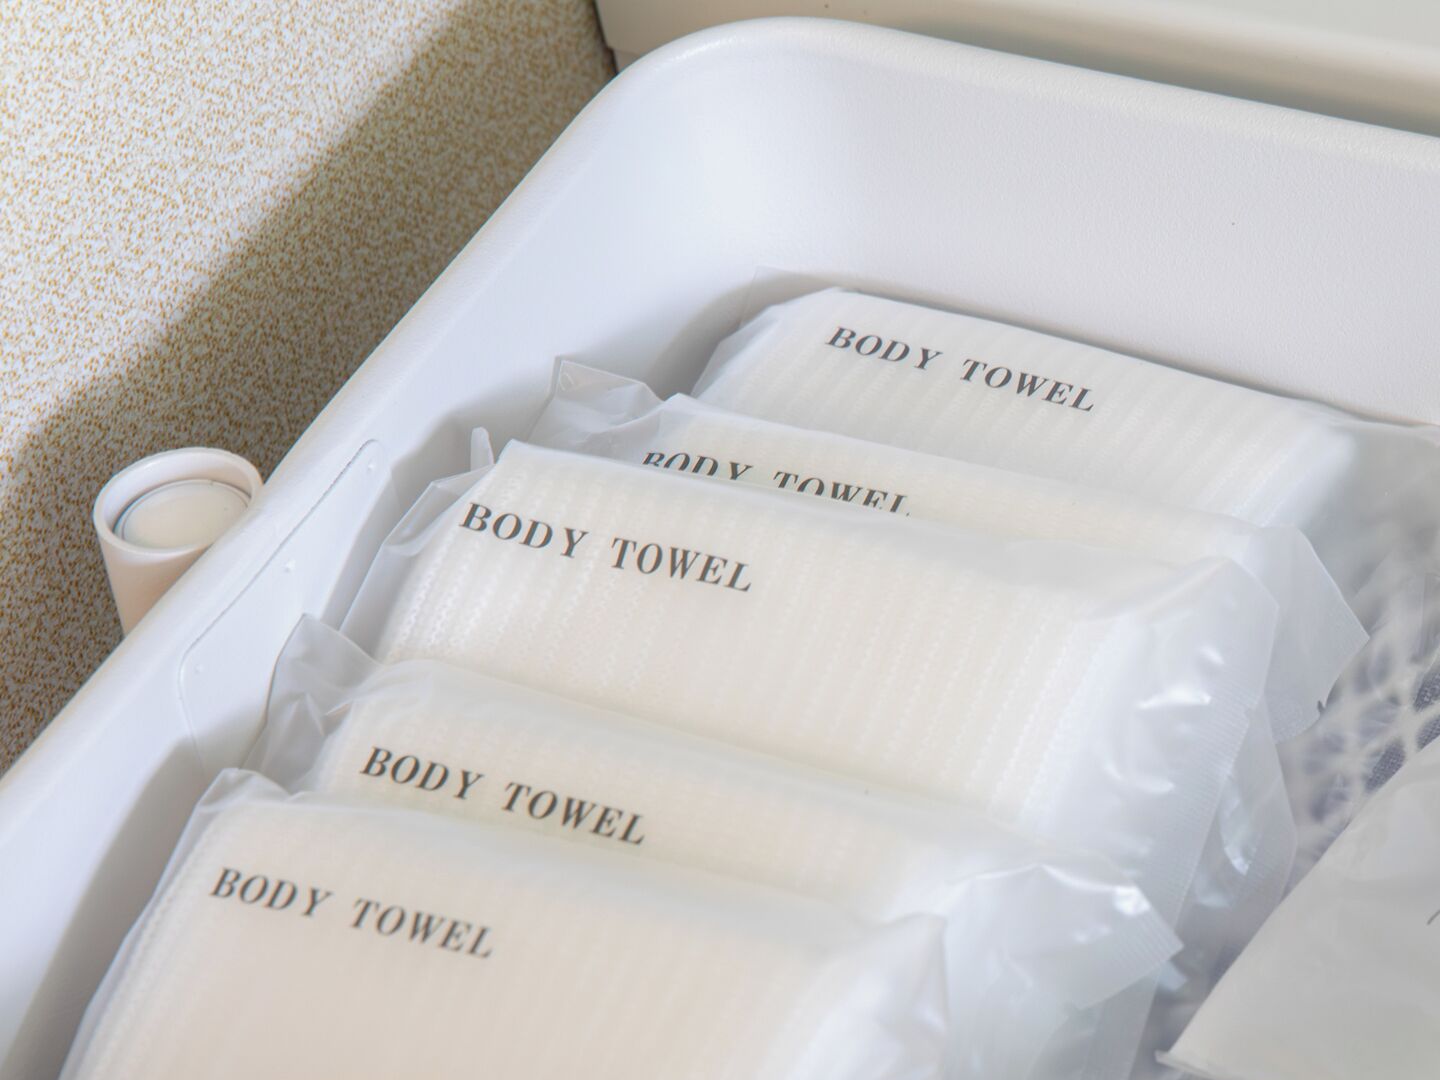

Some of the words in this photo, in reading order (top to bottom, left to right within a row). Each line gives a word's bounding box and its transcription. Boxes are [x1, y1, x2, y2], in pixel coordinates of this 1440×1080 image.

[826, 325, 943, 372] BODY
[961, 358, 1097, 413] TOWEL
[459, 501, 589, 558] BODY
[610, 536, 754, 593] TOWEL
[359, 745, 485, 802] BODY
[502, 780, 649, 847] TOWEL
[210, 867, 333, 919] BODY
[351, 897, 497, 960] TOWEL
